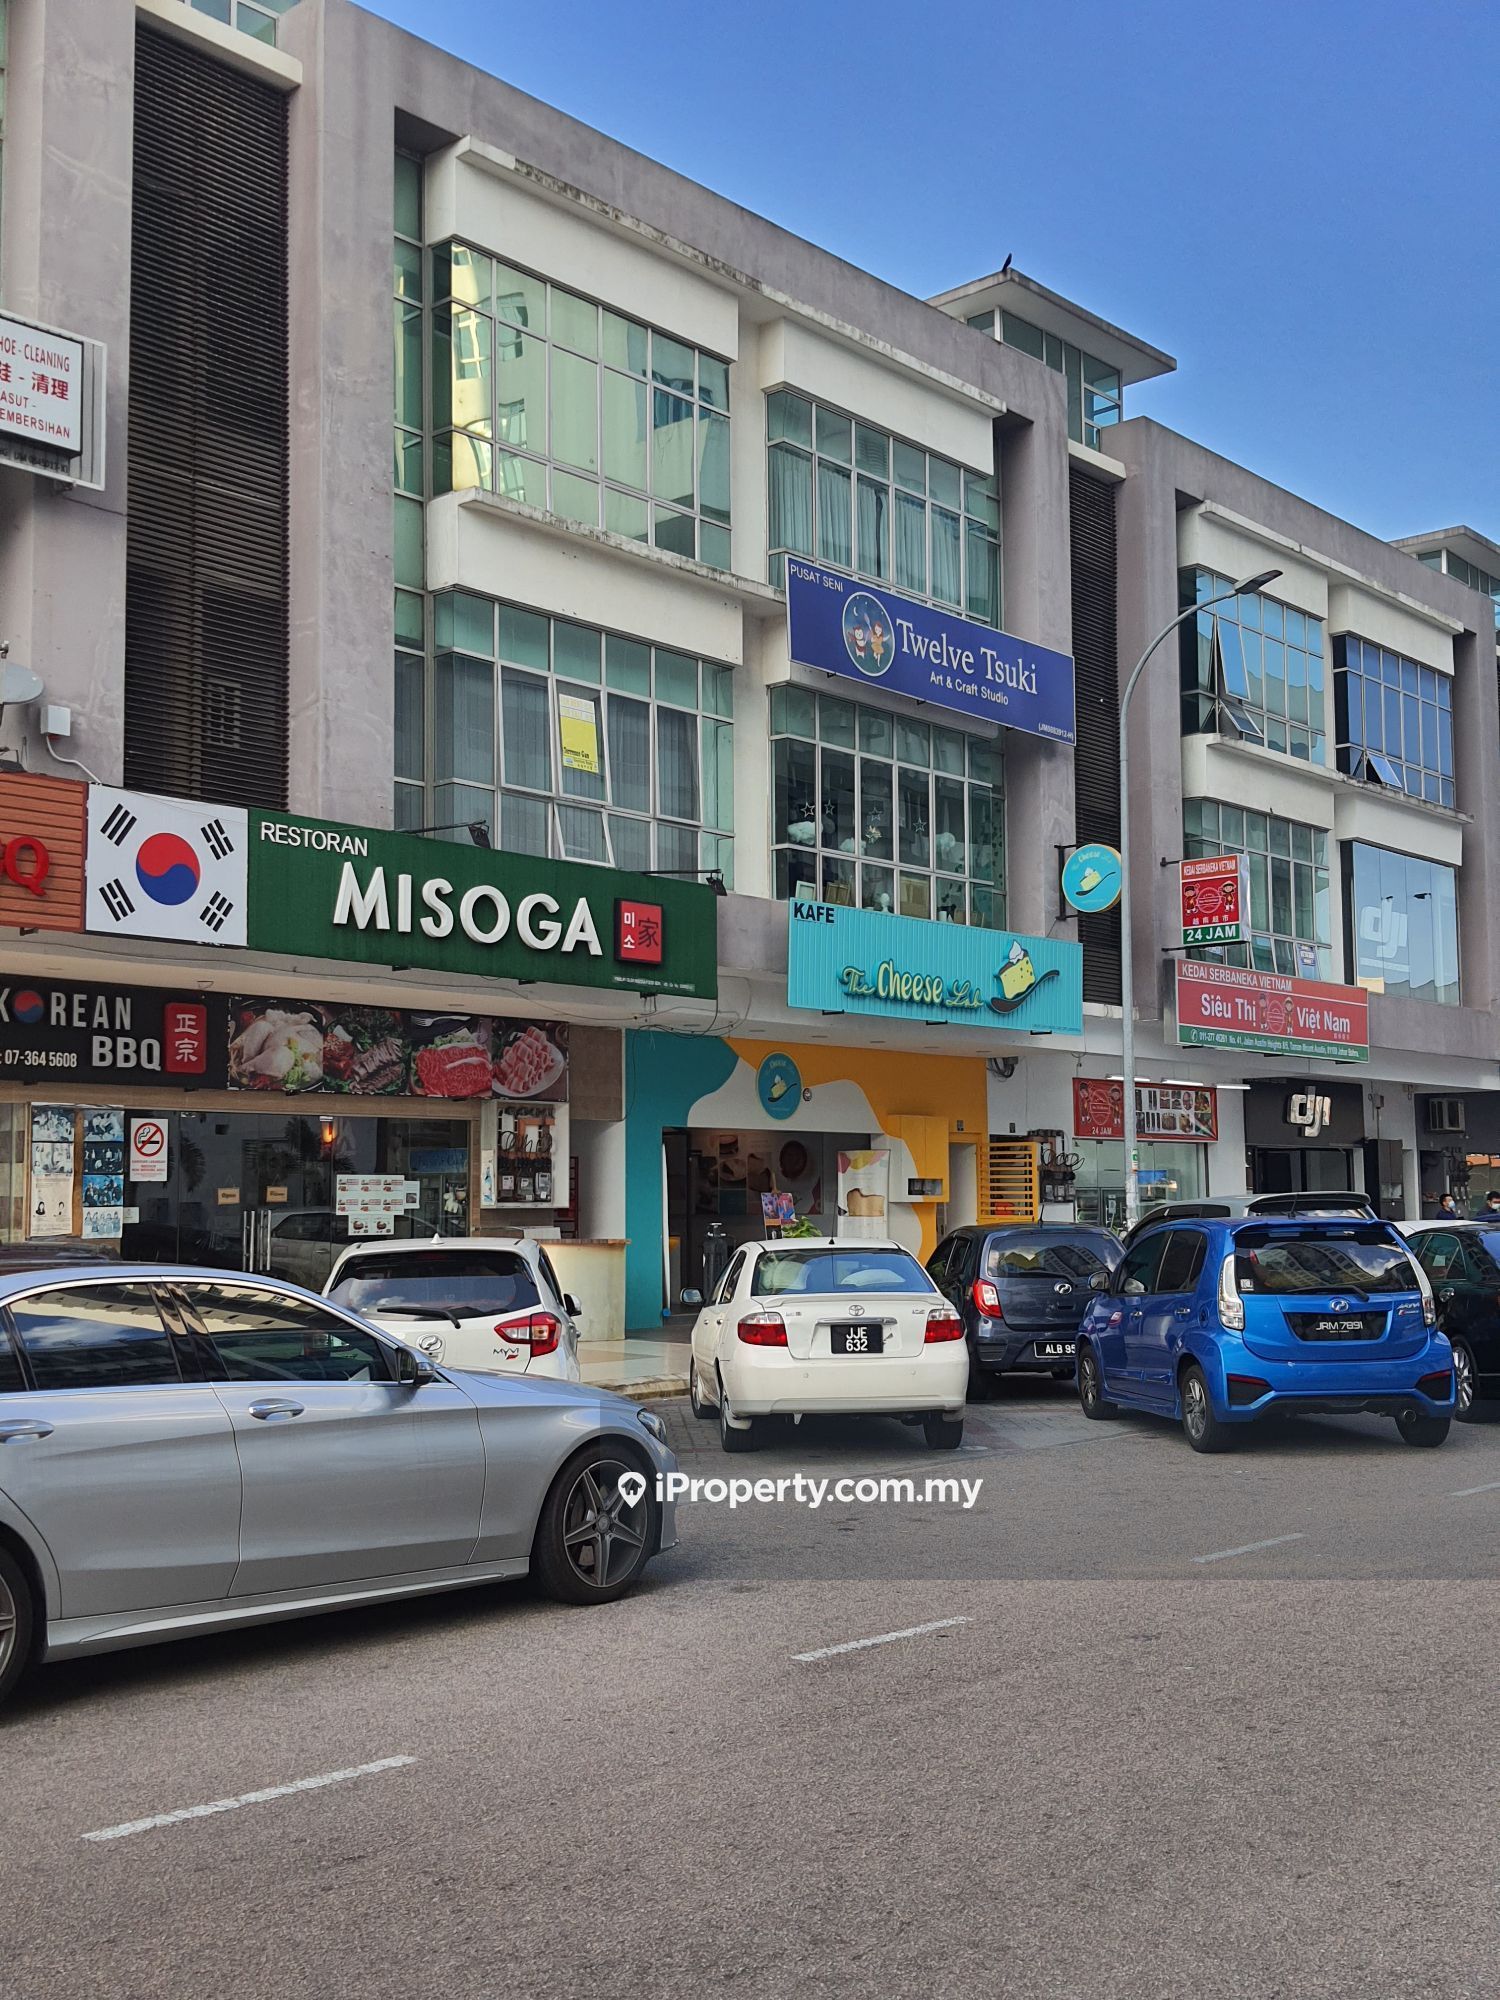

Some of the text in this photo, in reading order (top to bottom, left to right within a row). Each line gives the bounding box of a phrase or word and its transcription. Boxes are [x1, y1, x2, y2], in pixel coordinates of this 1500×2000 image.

[25, 344, 70, 372] CLEANING
[32, 371, 69, 400] 清理
[790, 564, 843, 592] PUSAT SENI
[896, 618, 1038, 695] Twelve Tsuki
[930, 671, 1009, 706] Art & Craft Studio
[261, 821, 369, 857] RESTORAN
[333, 862, 603, 957] MISOGA
[793, 902, 835, 924] KAFE
[623, 912, 636, 949] 미소
[638, 917, 659, 948] 家
[1186, 925, 1236, 942] 24 JAM
[843, 958, 985, 1008] The Cheese Lab
[1182, 964, 1292, 991] KEDAI SERBANEKA VIETNAM
[1201, 993, 1256, 1026] Siêu Thị
[1297, 1006, 1350, 1033] Việt Nam
[174, 1013, 200, 1063] 正宗
[4, 1050, 78, 1068] 07-364 5608
[92, 1035, 162, 1072] BBQ
[1091, 1126, 1112, 1136] 24 JAM
[846, 1326, 868, 1339] JJE
[1315, 1321, 1364, 1331] JRM 7891
[846, 1339, 868, 1351] 632
[1045, 1344, 1063, 1354] ALB
